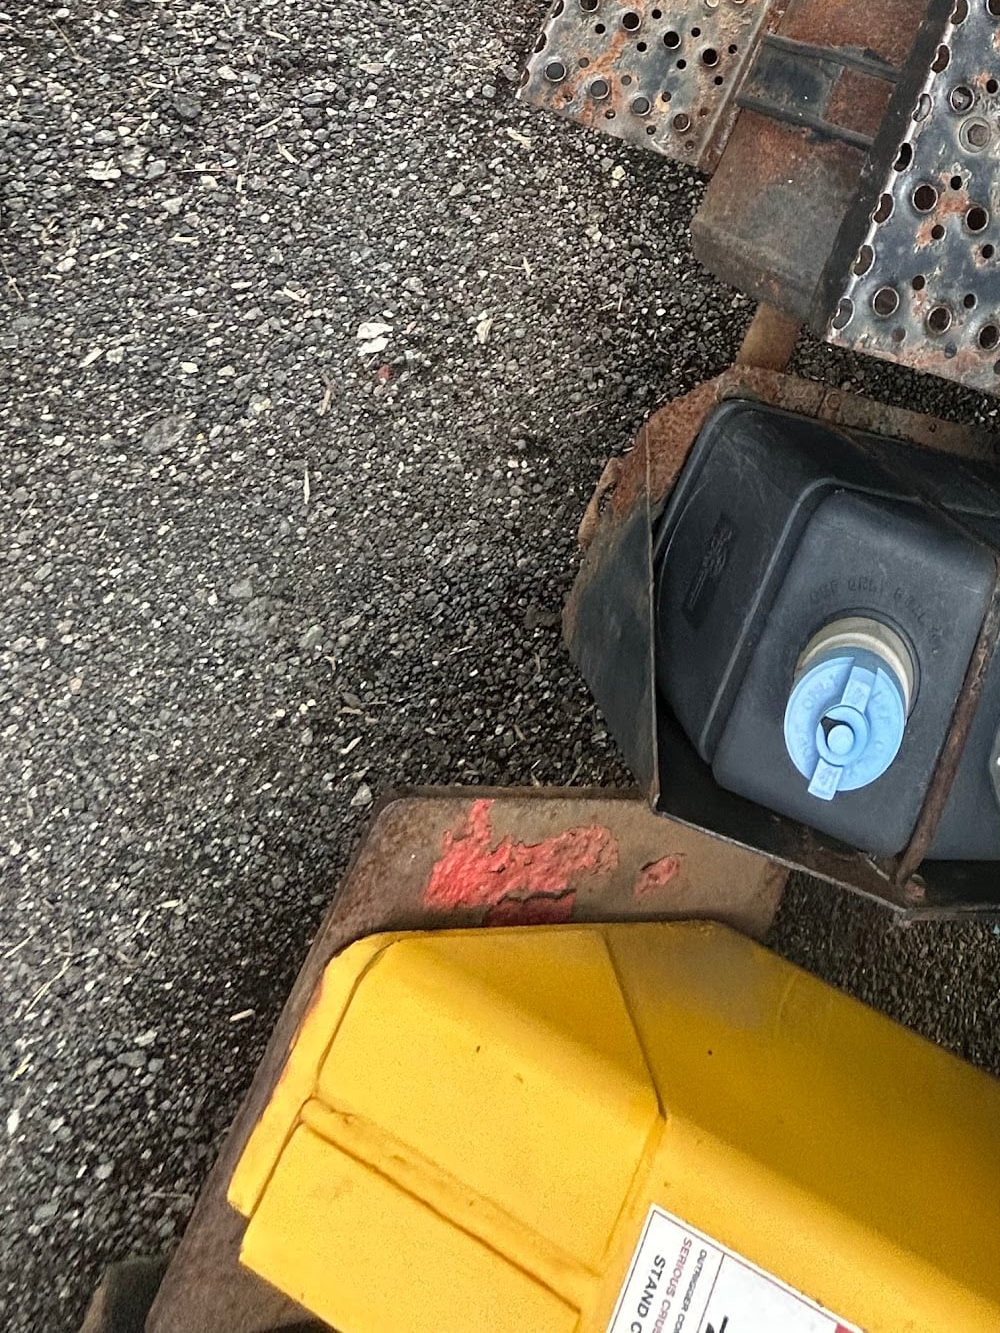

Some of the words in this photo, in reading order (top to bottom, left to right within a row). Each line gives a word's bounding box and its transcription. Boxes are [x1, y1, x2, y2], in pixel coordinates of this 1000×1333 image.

[637, 1254, 666, 1318] STAND
[666, 1237, 693, 1297] SERIOUS
[681, 1249, 707, 1312] OUTRIGGER
